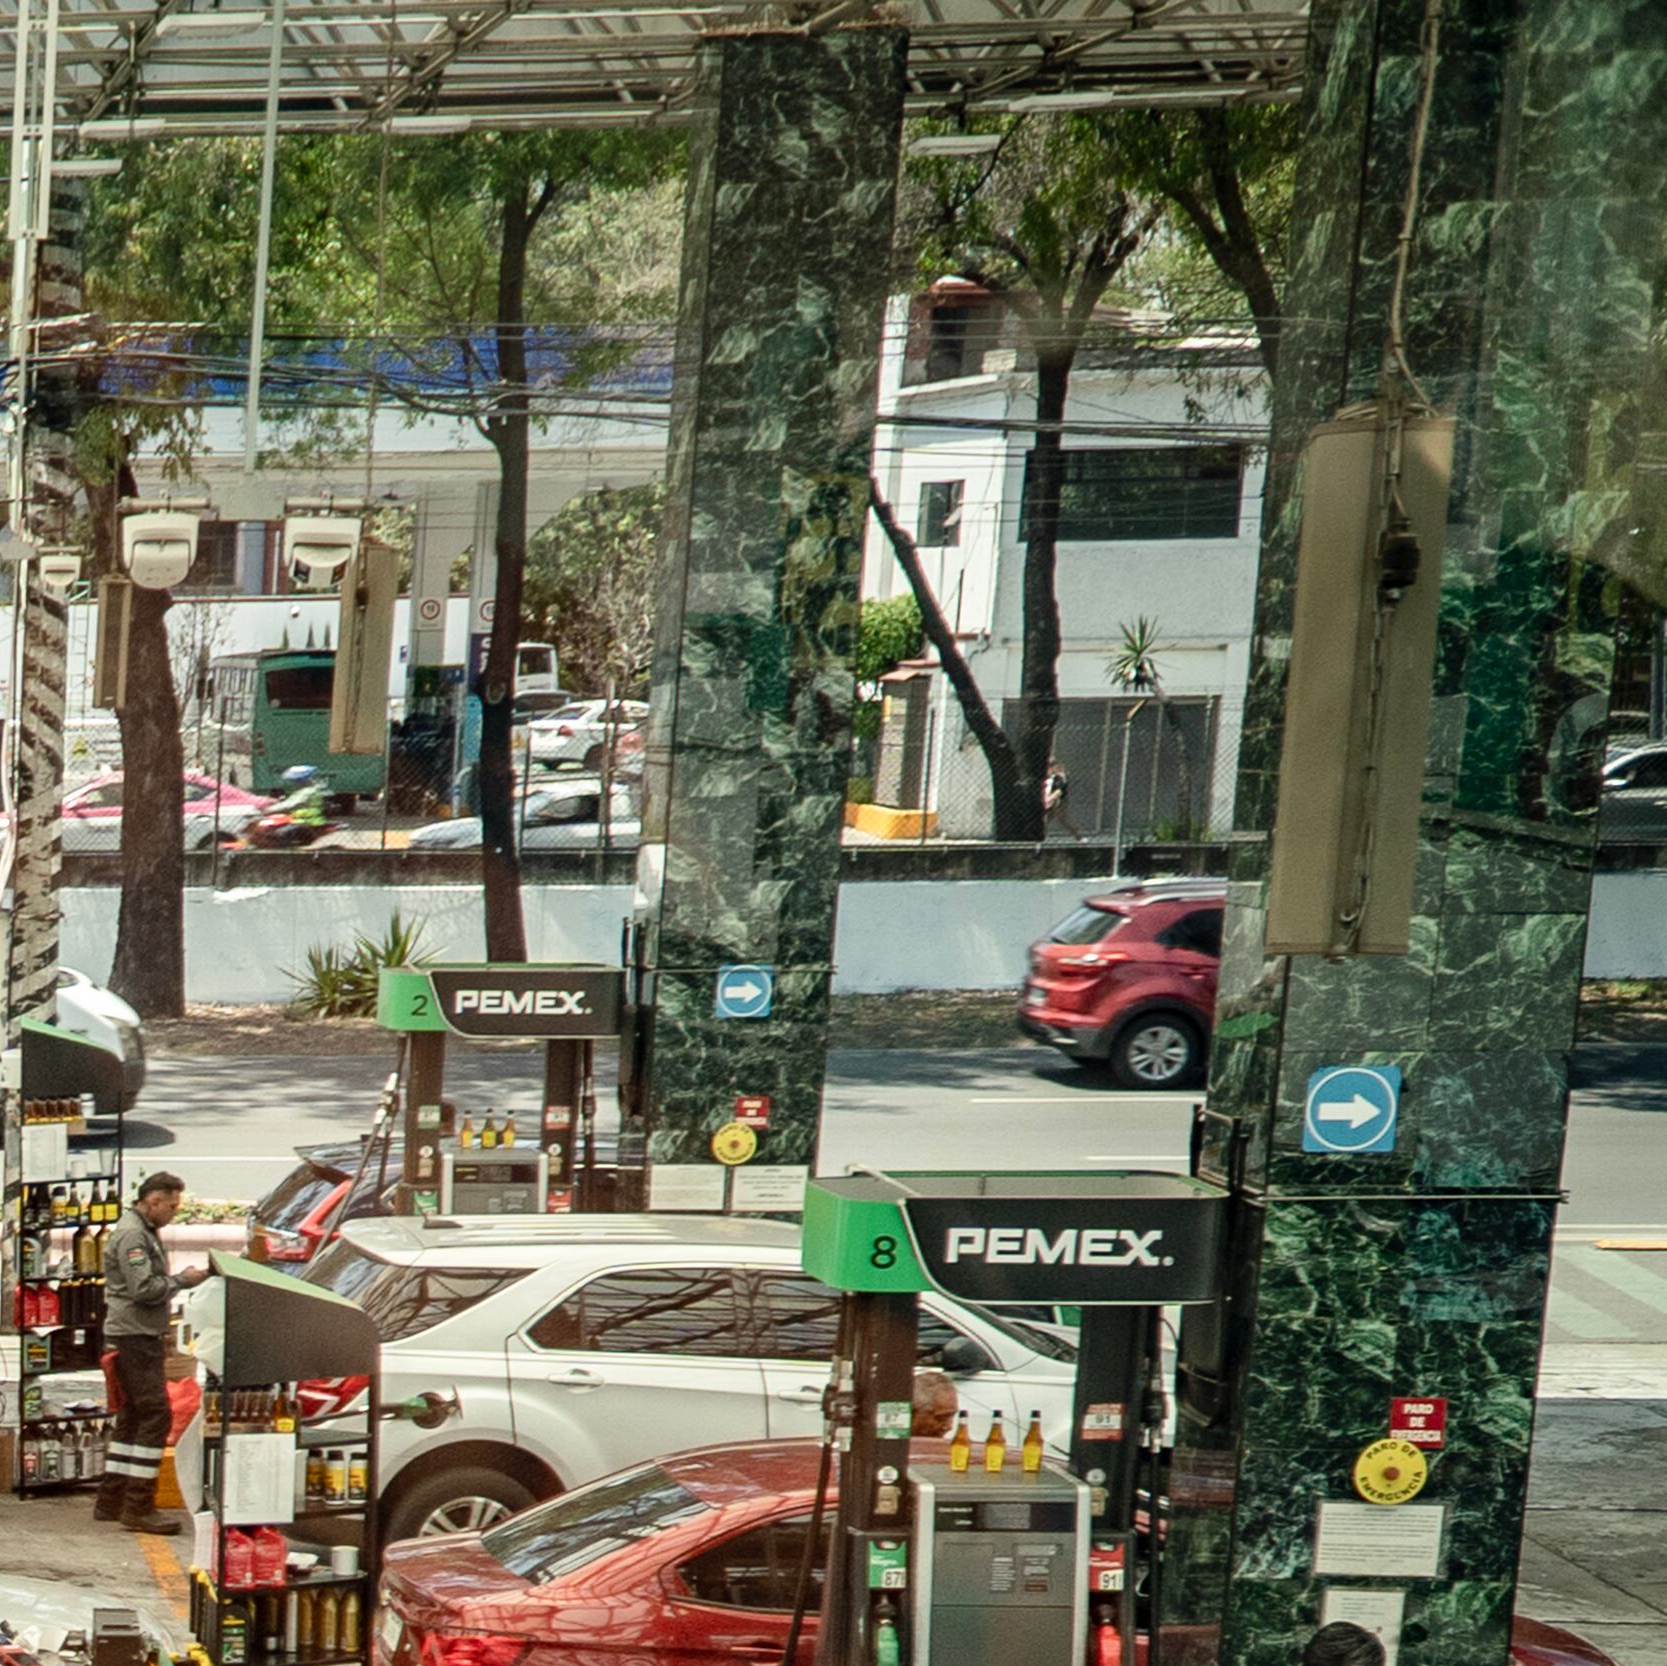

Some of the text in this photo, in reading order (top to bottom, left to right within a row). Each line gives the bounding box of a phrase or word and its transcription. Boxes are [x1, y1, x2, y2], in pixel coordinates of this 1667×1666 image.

[411, 995, 428, 1016] 2
[455, 990, 585, 1015] PEMEX
[871, 1235, 898, 1269] 8
[945, 1227, 1164, 1267] PEMEX
[1403, 1403, 1434, 1415] PARO
[1409, 1416, 1426, 1428] DE
[1367, 1442, 1417, 1459] PARO DE
[884, 1572, 899, 1587] 87
[1103, 1572, 1117, 1587] 91
